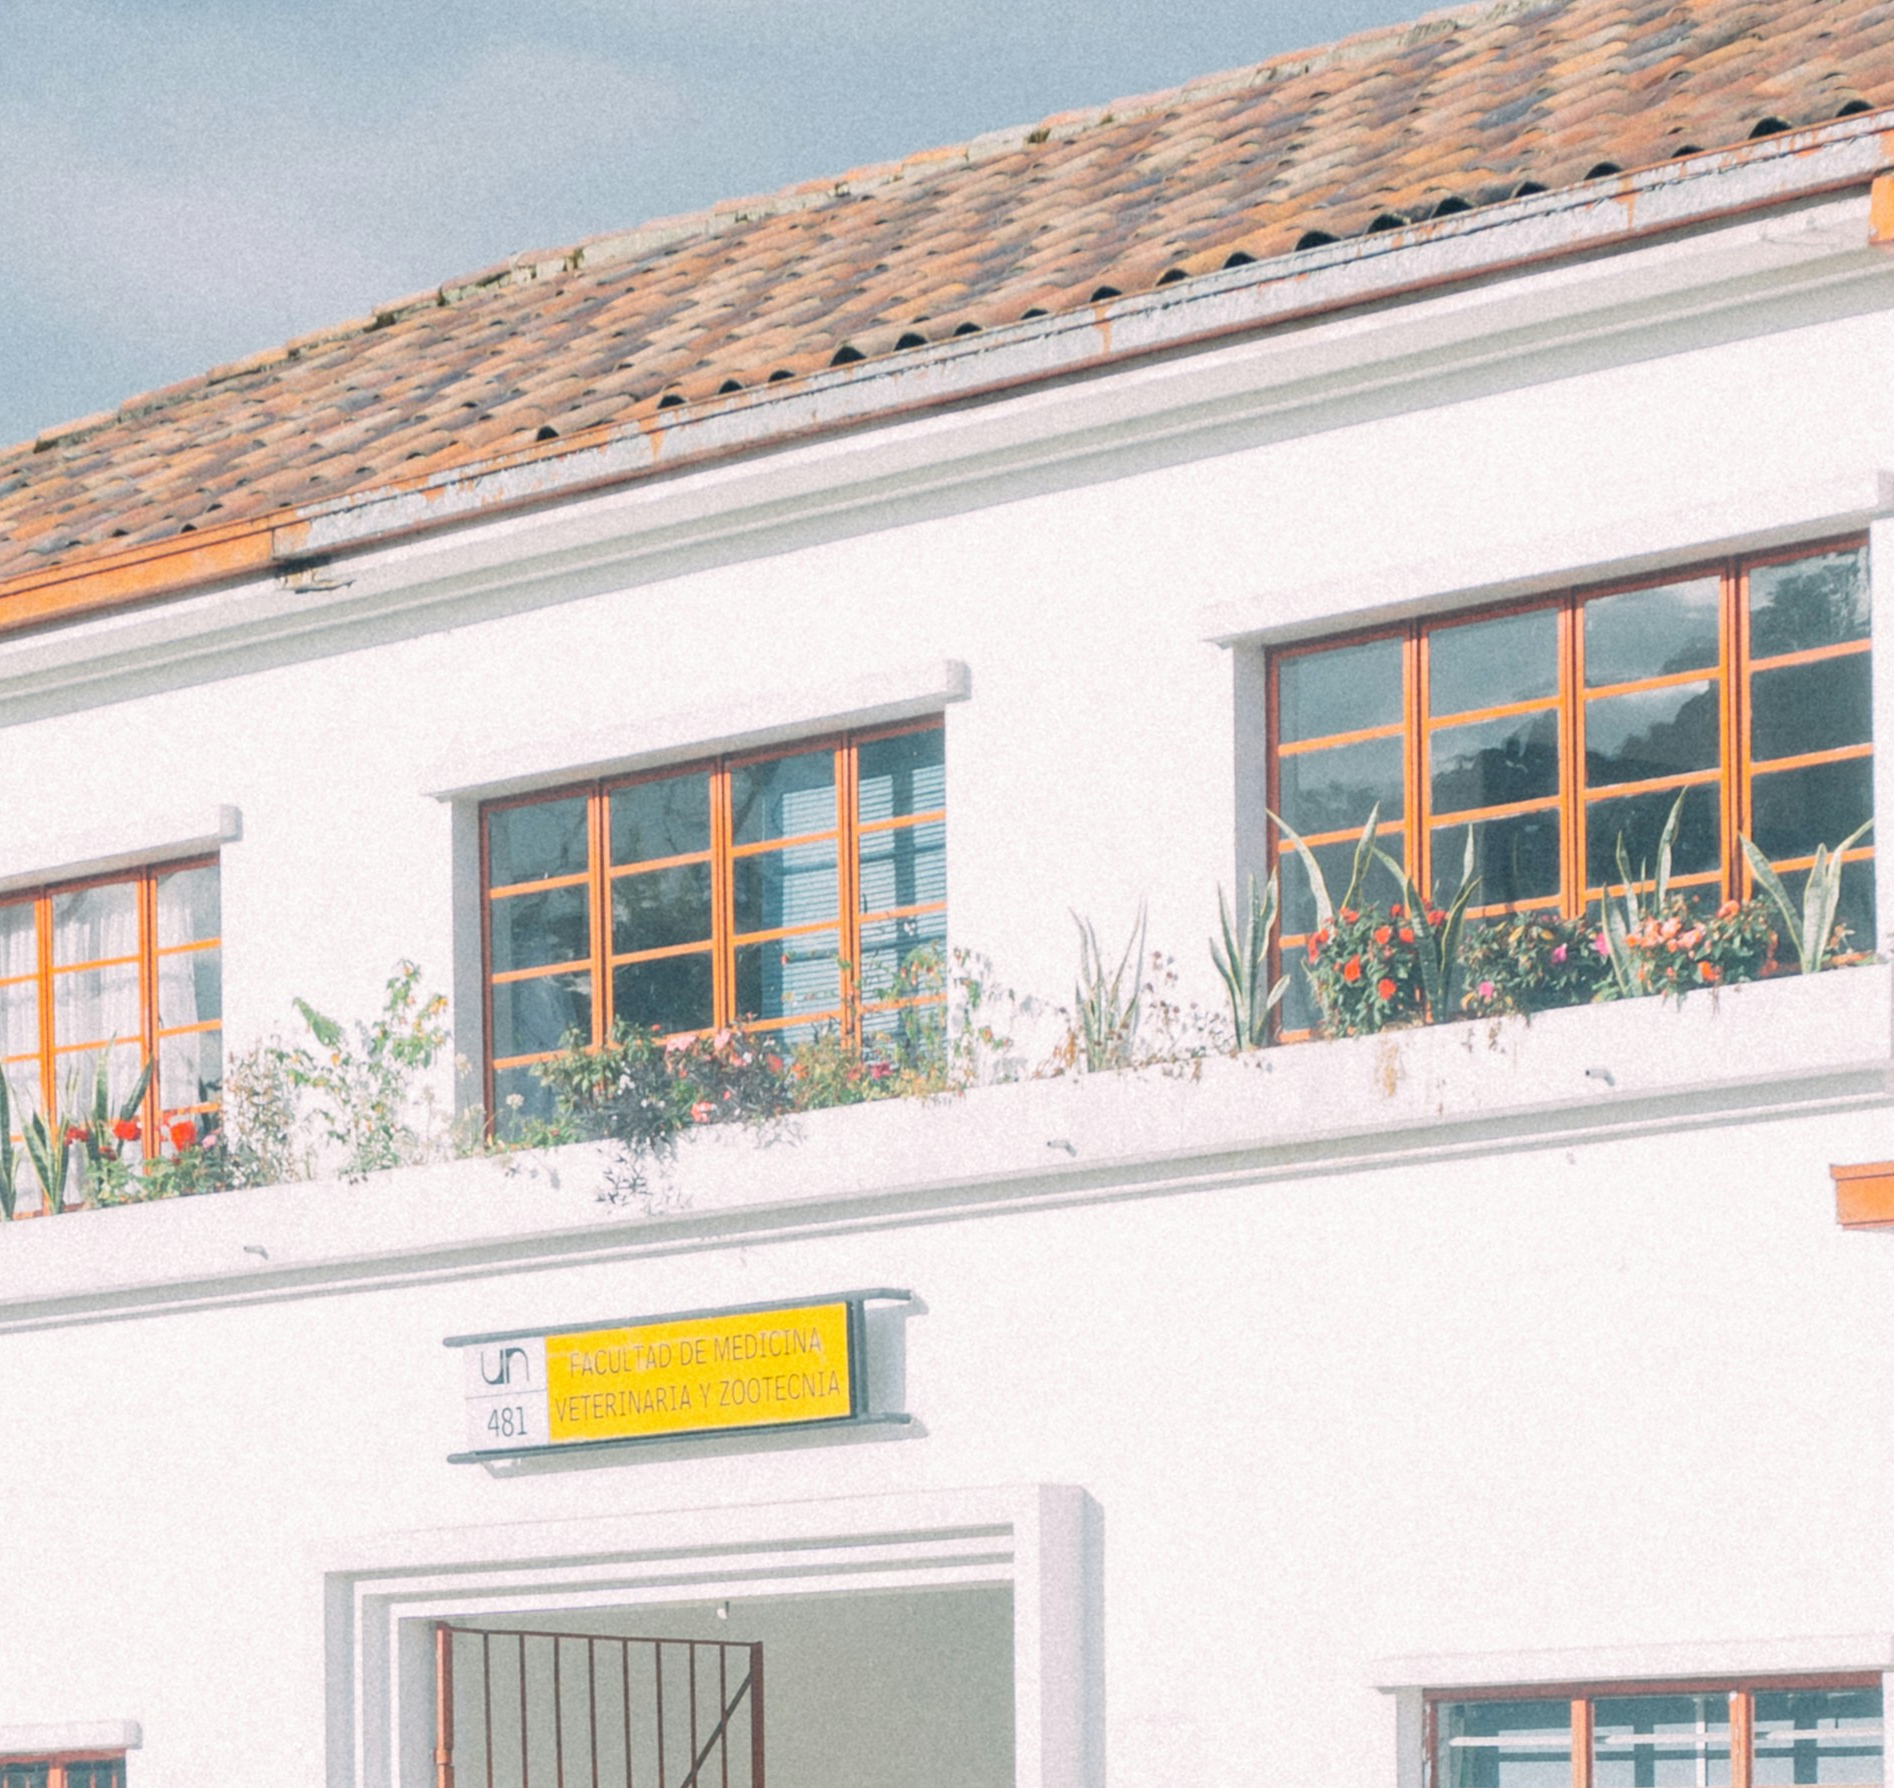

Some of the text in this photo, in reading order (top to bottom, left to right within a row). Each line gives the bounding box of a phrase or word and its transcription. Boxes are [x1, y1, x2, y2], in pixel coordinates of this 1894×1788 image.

[570, 1327, 823, 1378] FACULTAD DE MEDICINA
[487, 1406, 527, 1438] 481
[555, 1370, 841, 1424] VETERINARIA Y ZOOTECNIA
